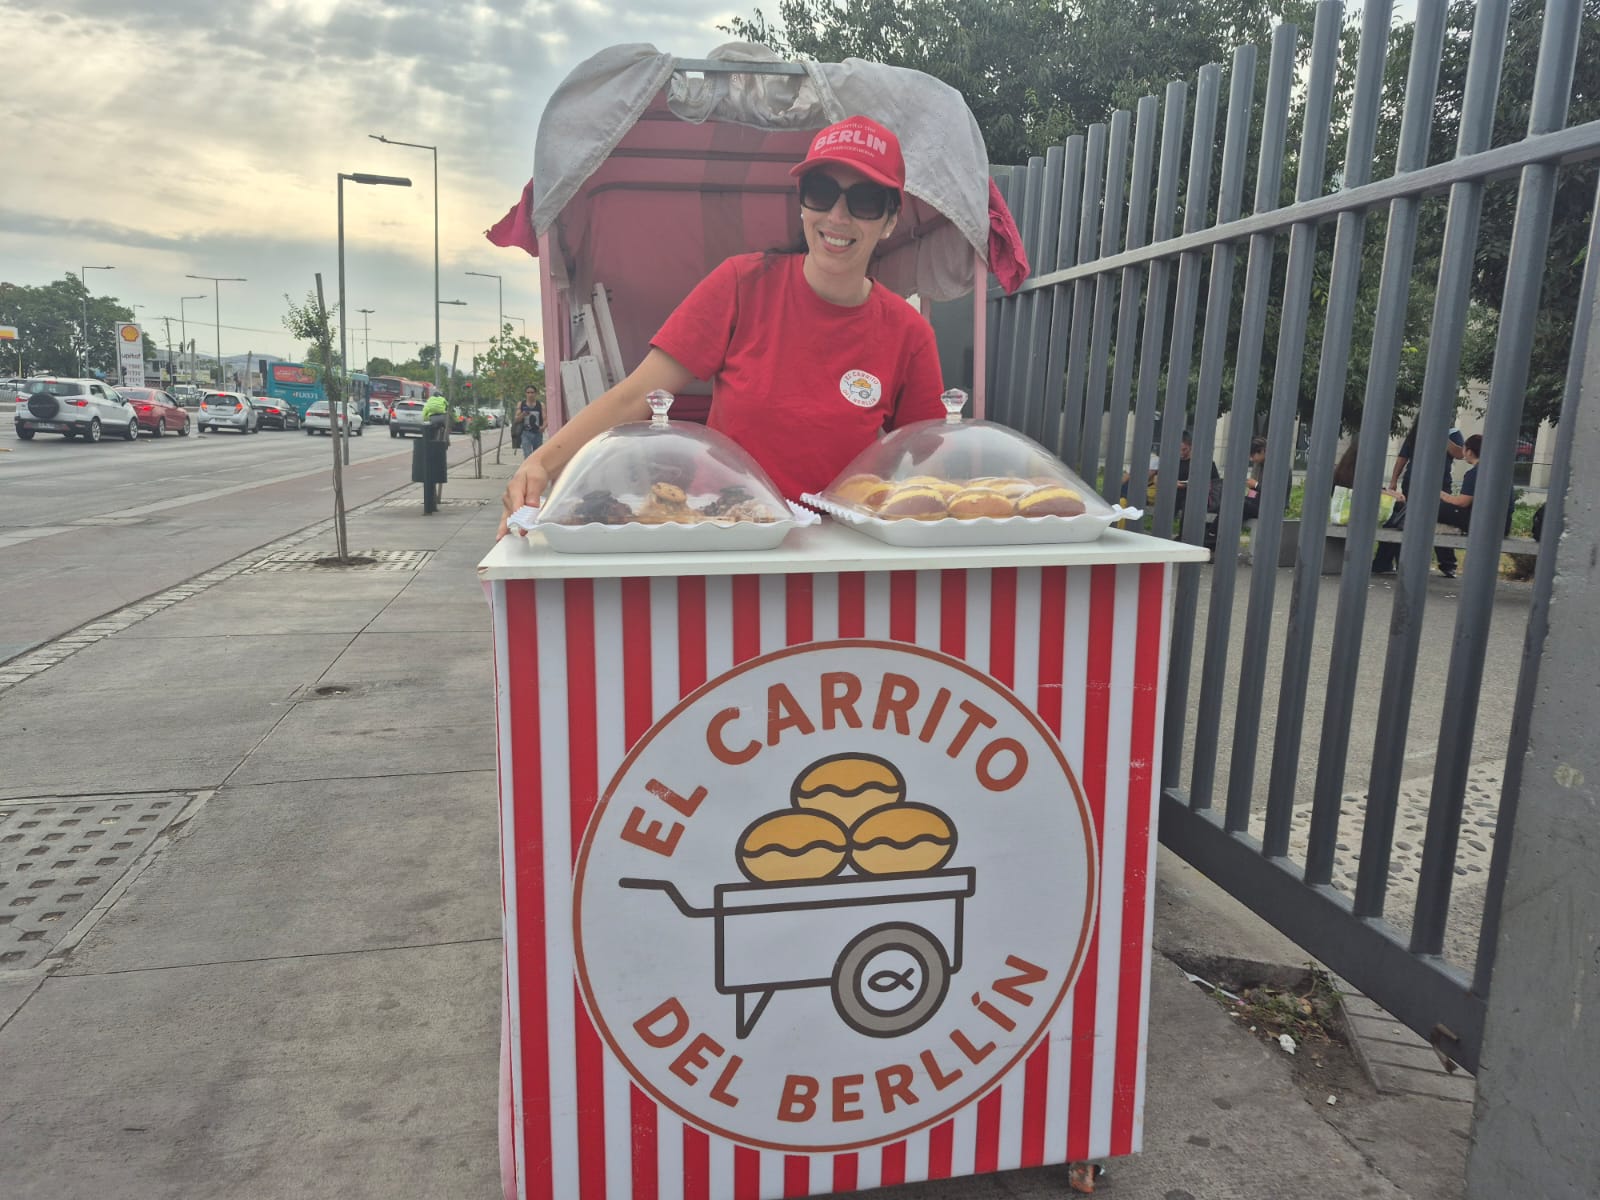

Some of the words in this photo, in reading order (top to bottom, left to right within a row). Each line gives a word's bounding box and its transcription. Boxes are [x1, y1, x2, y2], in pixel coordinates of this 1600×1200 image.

[815, 130, 886, 154] BERLIN
[620, 779, 708, 857] EL
[706, 672, 1029, 792] CARRITO
[633, 997, 743, 1107] DEL
[777, 954, 1048, 1122] BERLLÍN
